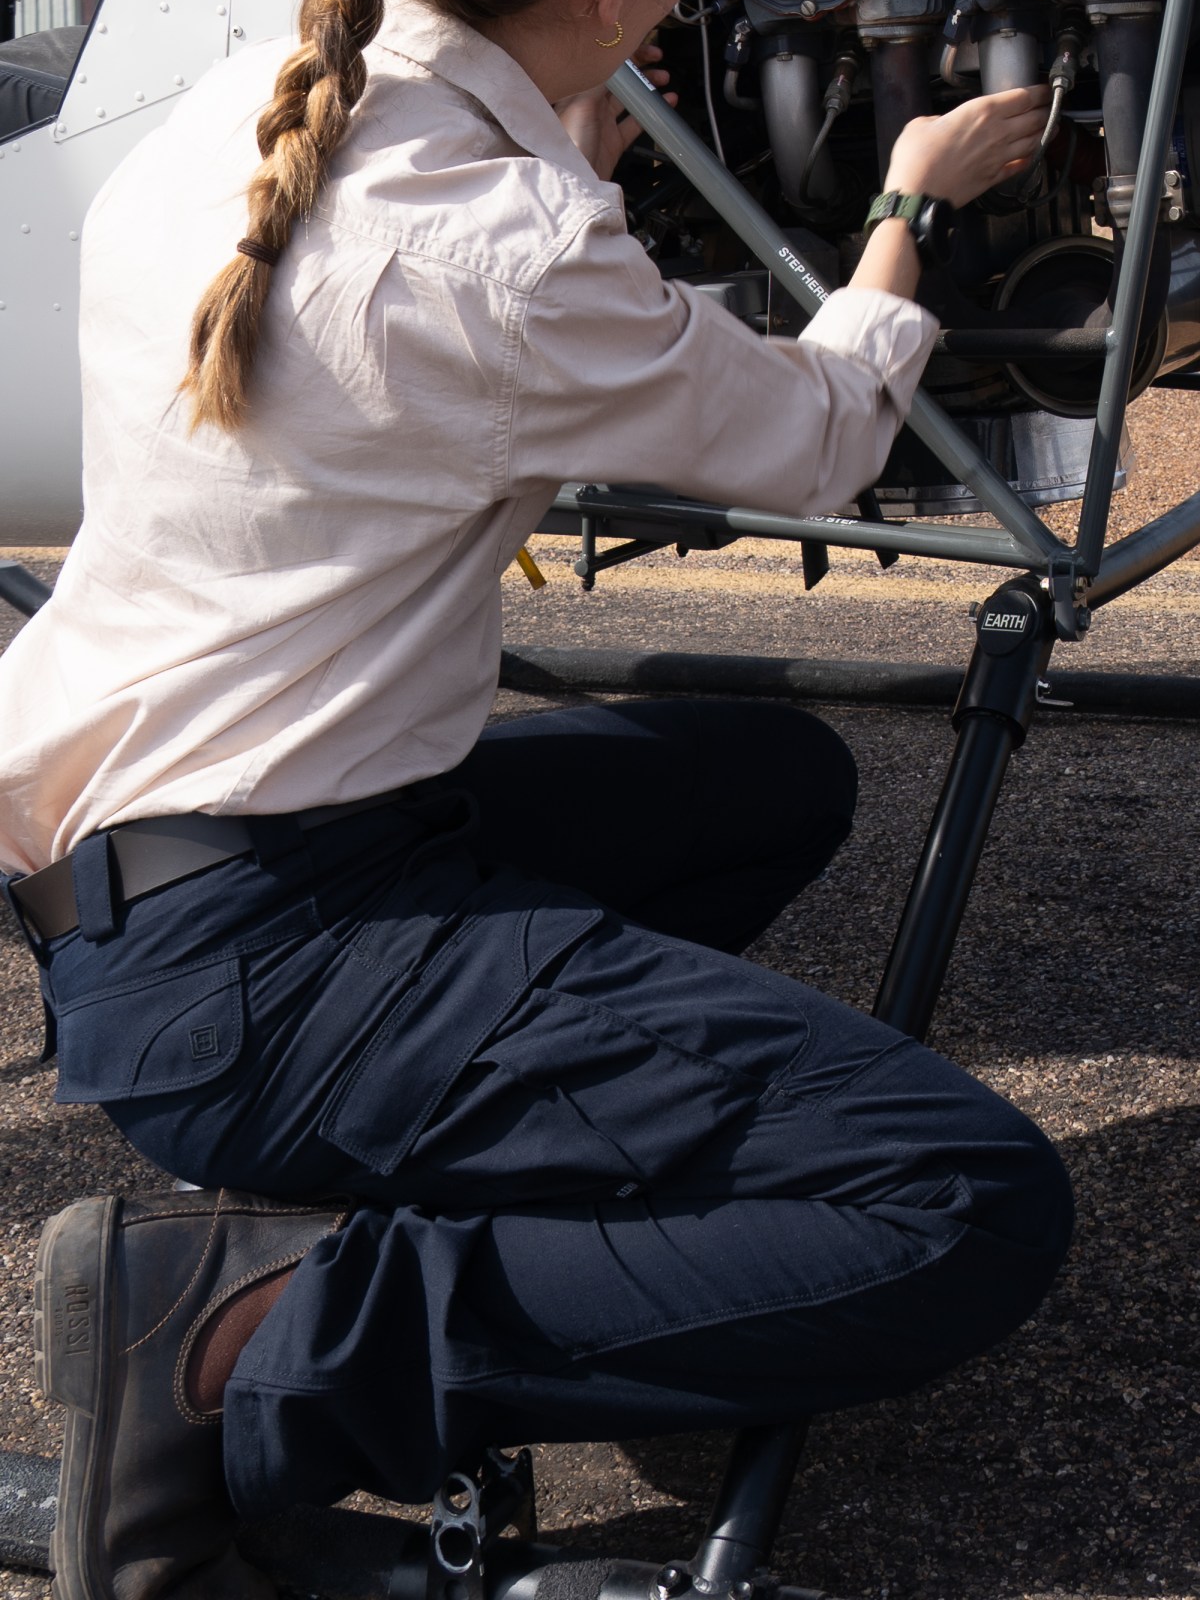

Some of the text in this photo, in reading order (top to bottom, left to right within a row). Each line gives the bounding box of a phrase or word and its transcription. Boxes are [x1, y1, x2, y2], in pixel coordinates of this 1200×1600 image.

[779, 247, 806, 273] STEP
[826, 517, 858, 525] STEP
[984, 613, 1026, 629] EARTH
[65, 1284, 90, 1357] ROSSI
